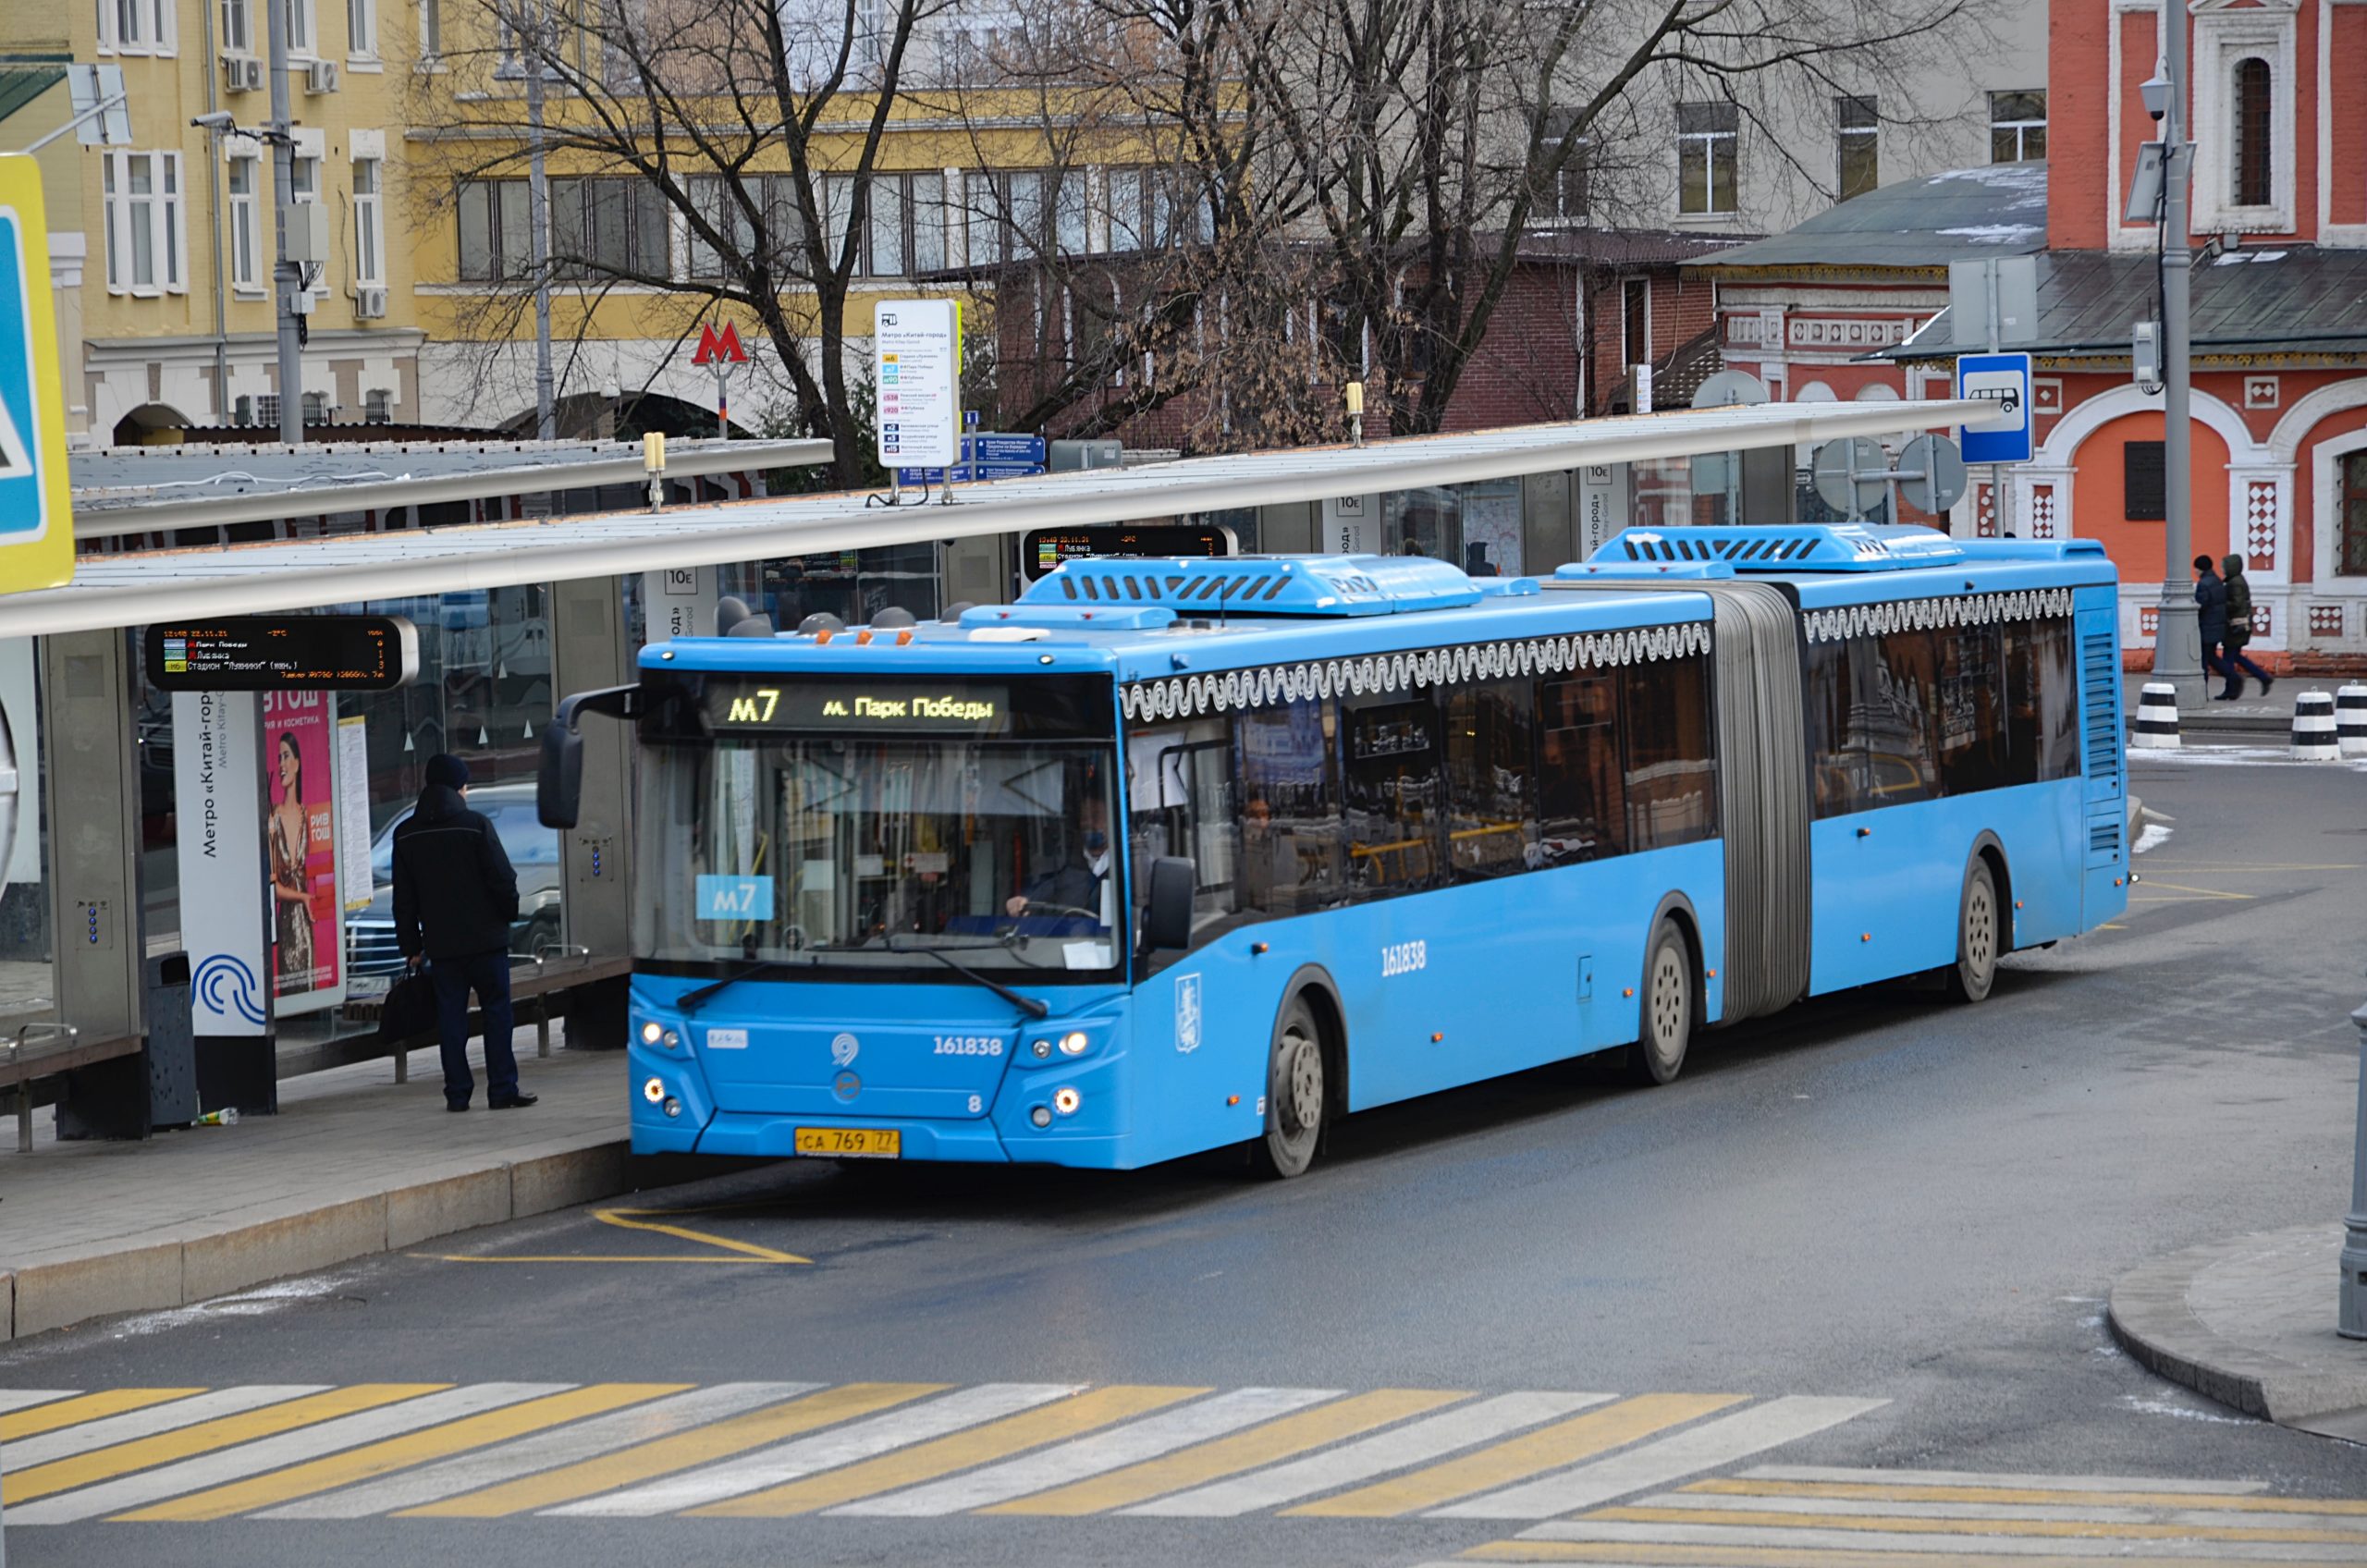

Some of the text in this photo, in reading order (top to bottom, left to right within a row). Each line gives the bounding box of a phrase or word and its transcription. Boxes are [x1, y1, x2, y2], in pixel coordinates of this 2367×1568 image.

[187, 661, 220, 671] Стадион
[854, 697, 906, 720] Парк
[912, 695, 994, 721] Победы
[218, 733, 227, 768] Metro
[199, 691, 218, 858] Метро «Китай-гор
[311, 813, 329, 828] РИВ
[311, 827, 330, 842] ГОШ
[1381, 939, 1427, 978] 161838
[933, 1035, 1002, 1056] 161838
[967, 1095, 982, 1113] 8
[833, 1132, 865, 1151] 769
[876, 1132, 893, 1146] 77
